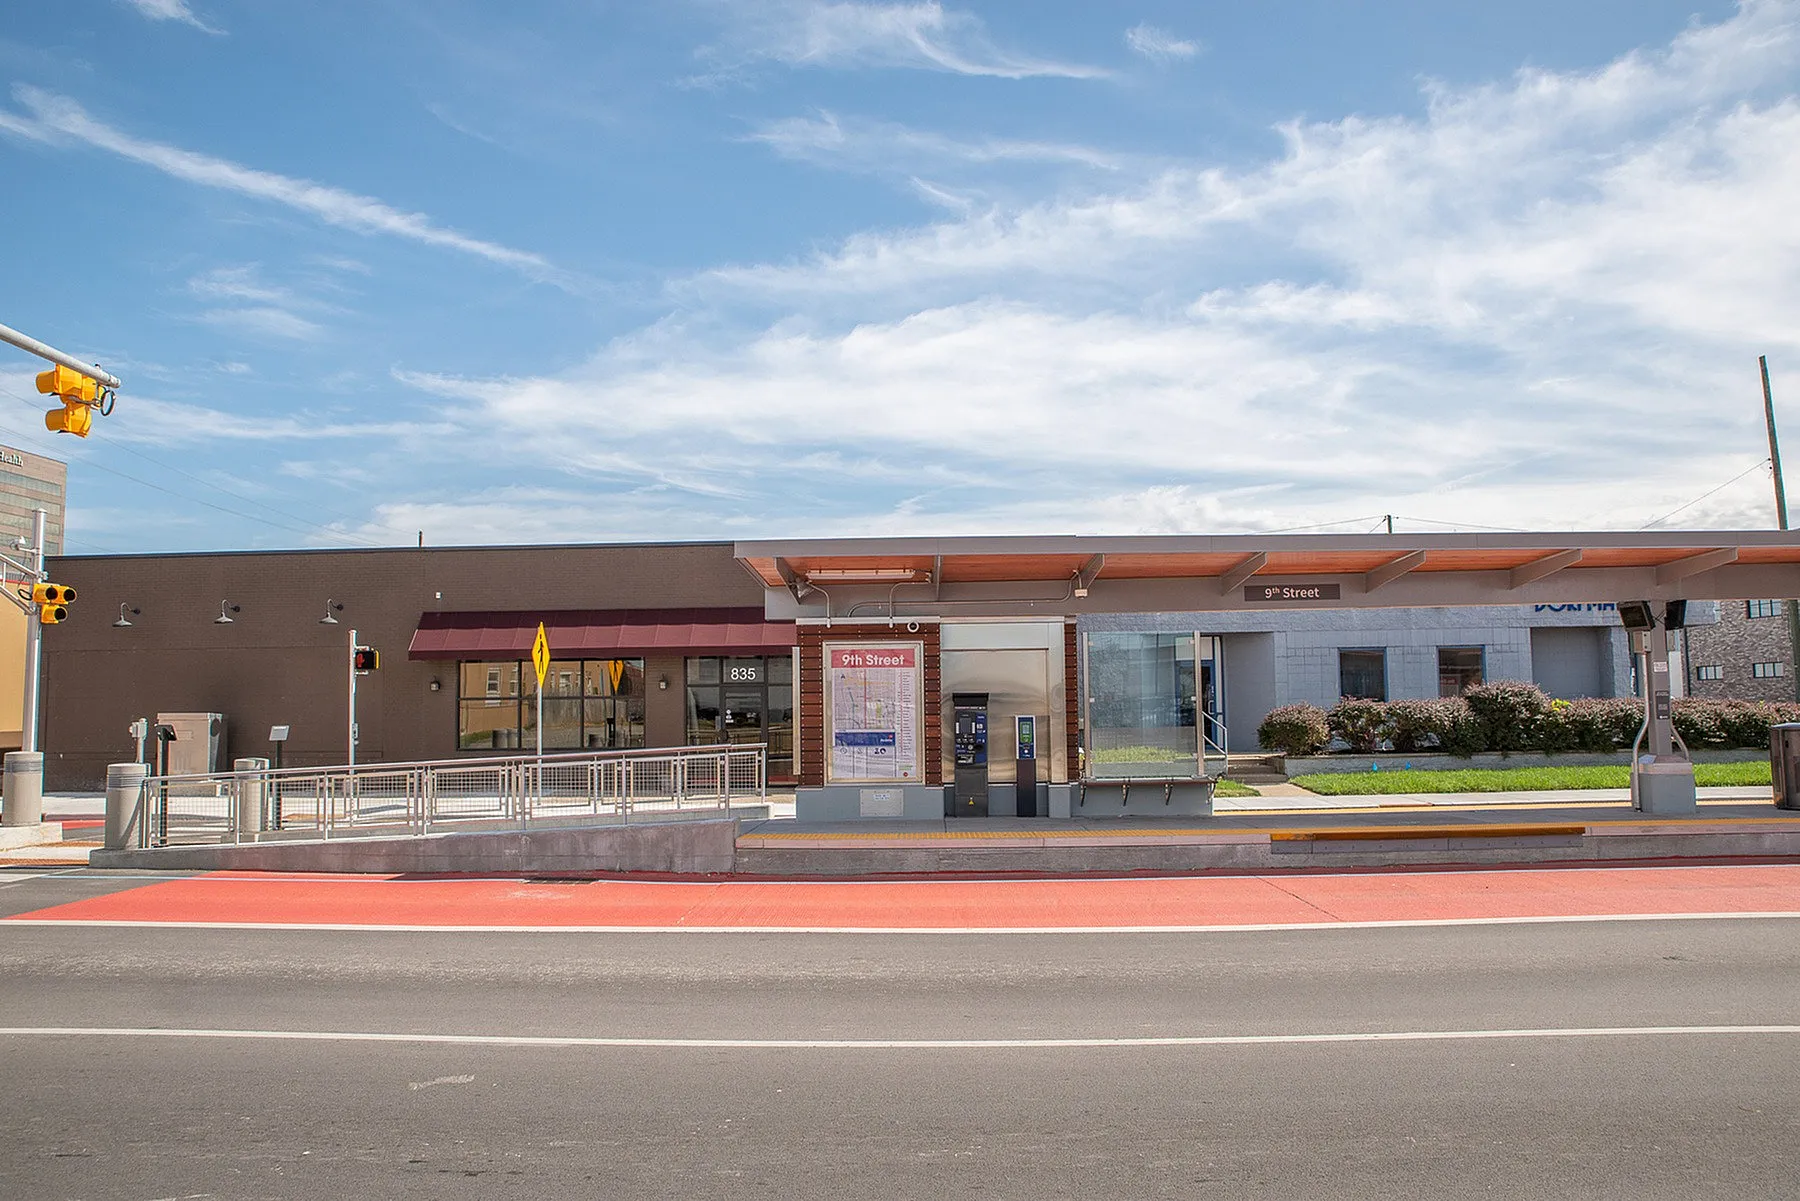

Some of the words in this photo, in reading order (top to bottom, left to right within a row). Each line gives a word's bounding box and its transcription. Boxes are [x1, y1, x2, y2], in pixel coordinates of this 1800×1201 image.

[1265, 587, 1280, 599] 9th
[1283, 587, 1320, 598] Street
[842, 654, 863, 666] 9th
[866, 654, 905, 666] Street
[731, 667, 756, 680] 835
